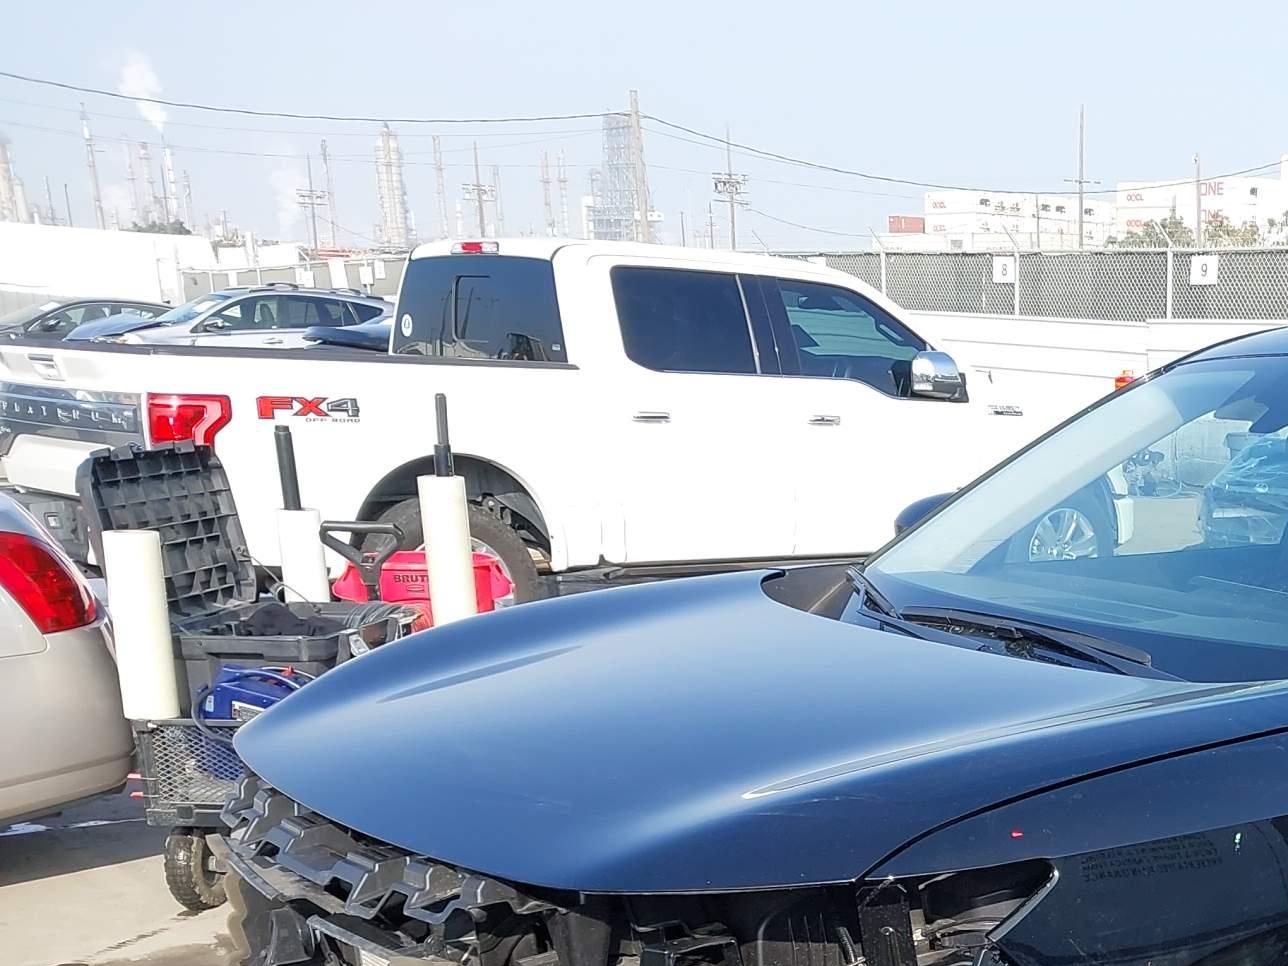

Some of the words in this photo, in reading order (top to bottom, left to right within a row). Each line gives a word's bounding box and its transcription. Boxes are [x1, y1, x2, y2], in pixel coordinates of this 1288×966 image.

[1001, 263, 1008, 277] 8
[1201, 263, 1208, 277] 9
[256, 396, 361, 419] FX4
[393, 574, 429, 583] BRUT
